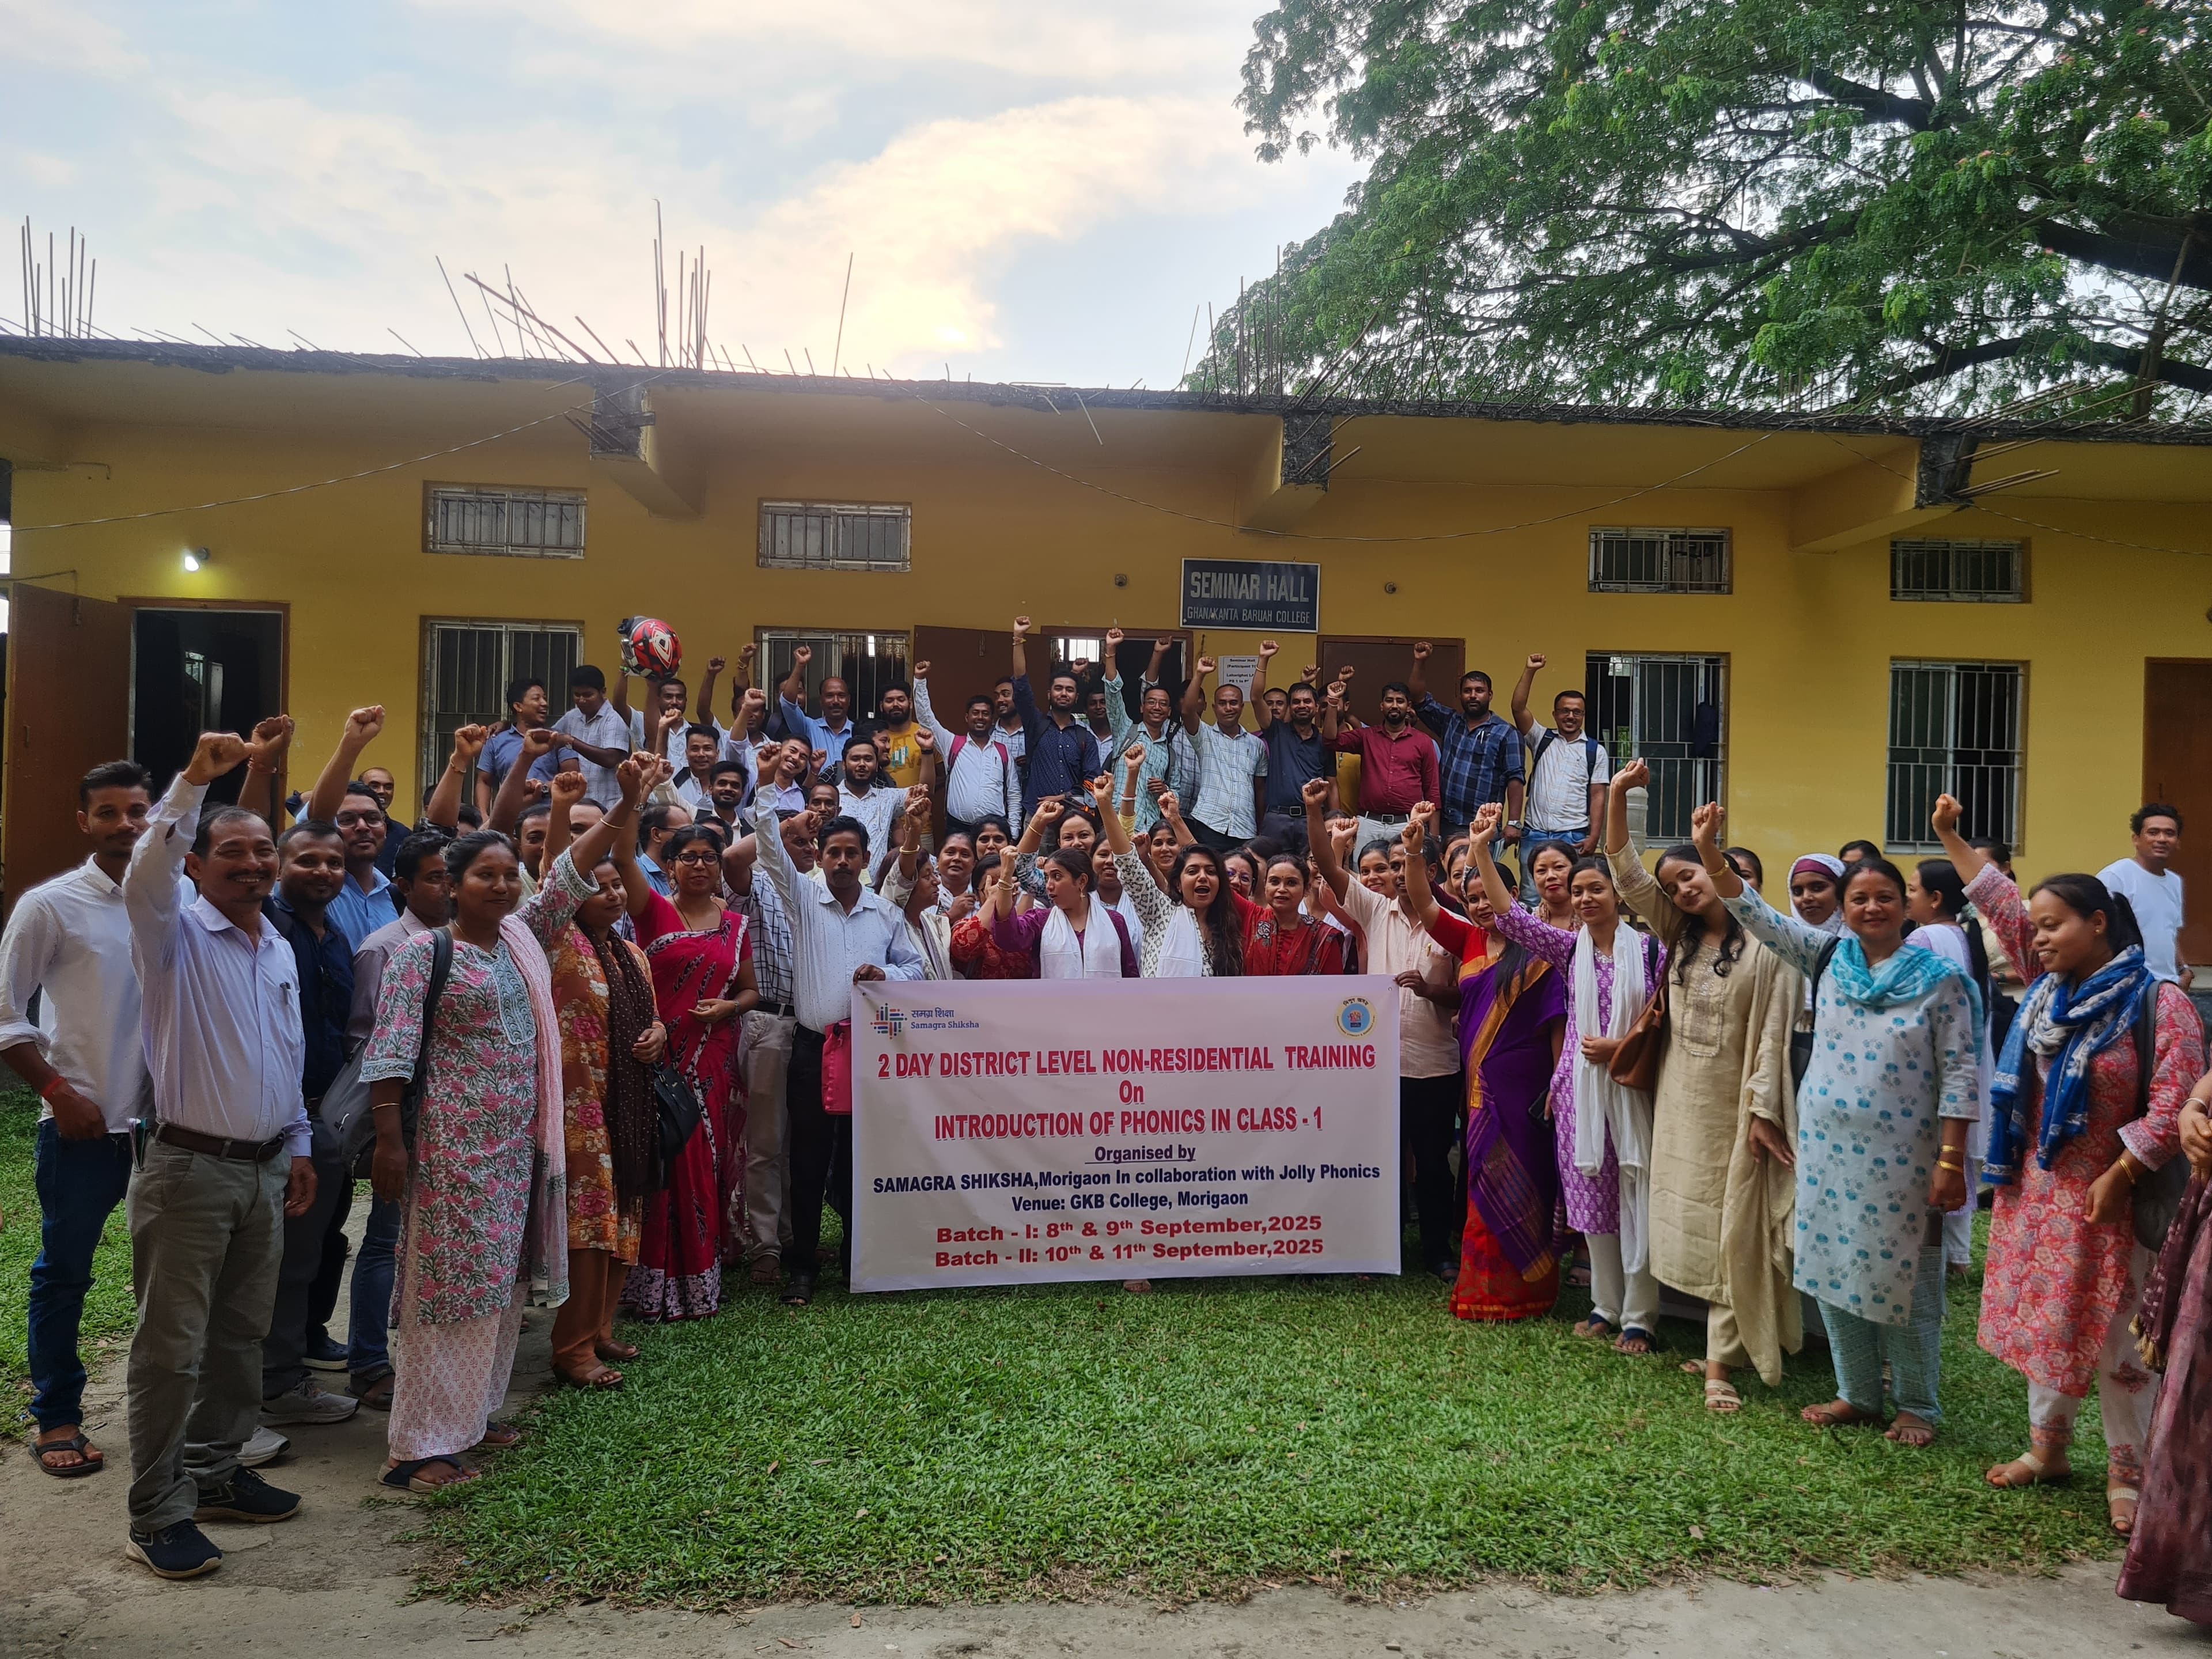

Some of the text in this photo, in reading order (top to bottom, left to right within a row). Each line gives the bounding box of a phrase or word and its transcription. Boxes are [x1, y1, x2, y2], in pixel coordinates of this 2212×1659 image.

[1190, 571, 1309, 603] SEMINAR HALL
[1187, 606, 1310, 624] GHANAKANTA BARUAH COLLEGE
[911, 1007, 954, 1018] समग्र शिक्षा
[911, 1022, 946, 1030] Samagra
[878, 1044, 1376, 1078] 2 DAY DISTRICT LEVEL NON-RESIDENTIAL TRAINING
[1119, 1080, 1144, 1103] On
[935, 1112, 1083, 1139] INTRODUCTION
[1089, 1111, 1115, 1135] OF
[1121, 1108, 1205, 1134] PHONICS
[1211, 1108, 1230, 1131] IN
[1237, 1106, 1297, 1131] CLASS
[1313, 1106, 1322, 1130] 1
[1095, 1145, 1196, 1164] Organised by
[873, 1175, 956, 1193] SAMAGRA
[1116, 1169, 1130, 1184] In
[1135, 1166, 1236, 1184] collaboration
[1241, 1165, 1274, 1180] with
[1279, 1164, 1315, 1183] Jolly
[1320, 1164, 1380, 1179] Phonics
[1012, 1191, 1248, 1211] Venue: GKB College, Morigaon
[937, 1226, 1003, 1243] Batch
[1025, 1224, 1038, 1239] I:
[1047, 1222, 1073, 1238] 8th
[1081, 1222, 1098, 1236] &
[1106, 1220, 1133, 1236] 9th
[1141, 1215, 1323, 1237] September,2025
[935, 1251, 998, 1267] Batch
[1019, 1248, 1037, 1263] II:
[1045, 1245, 1081, 1262] 10th
[1089, 1245, 1104, 1260] &
[1112, 1244, 1146, 1259] 11th
[1153, 1238, 1324, 1260] September,2025
